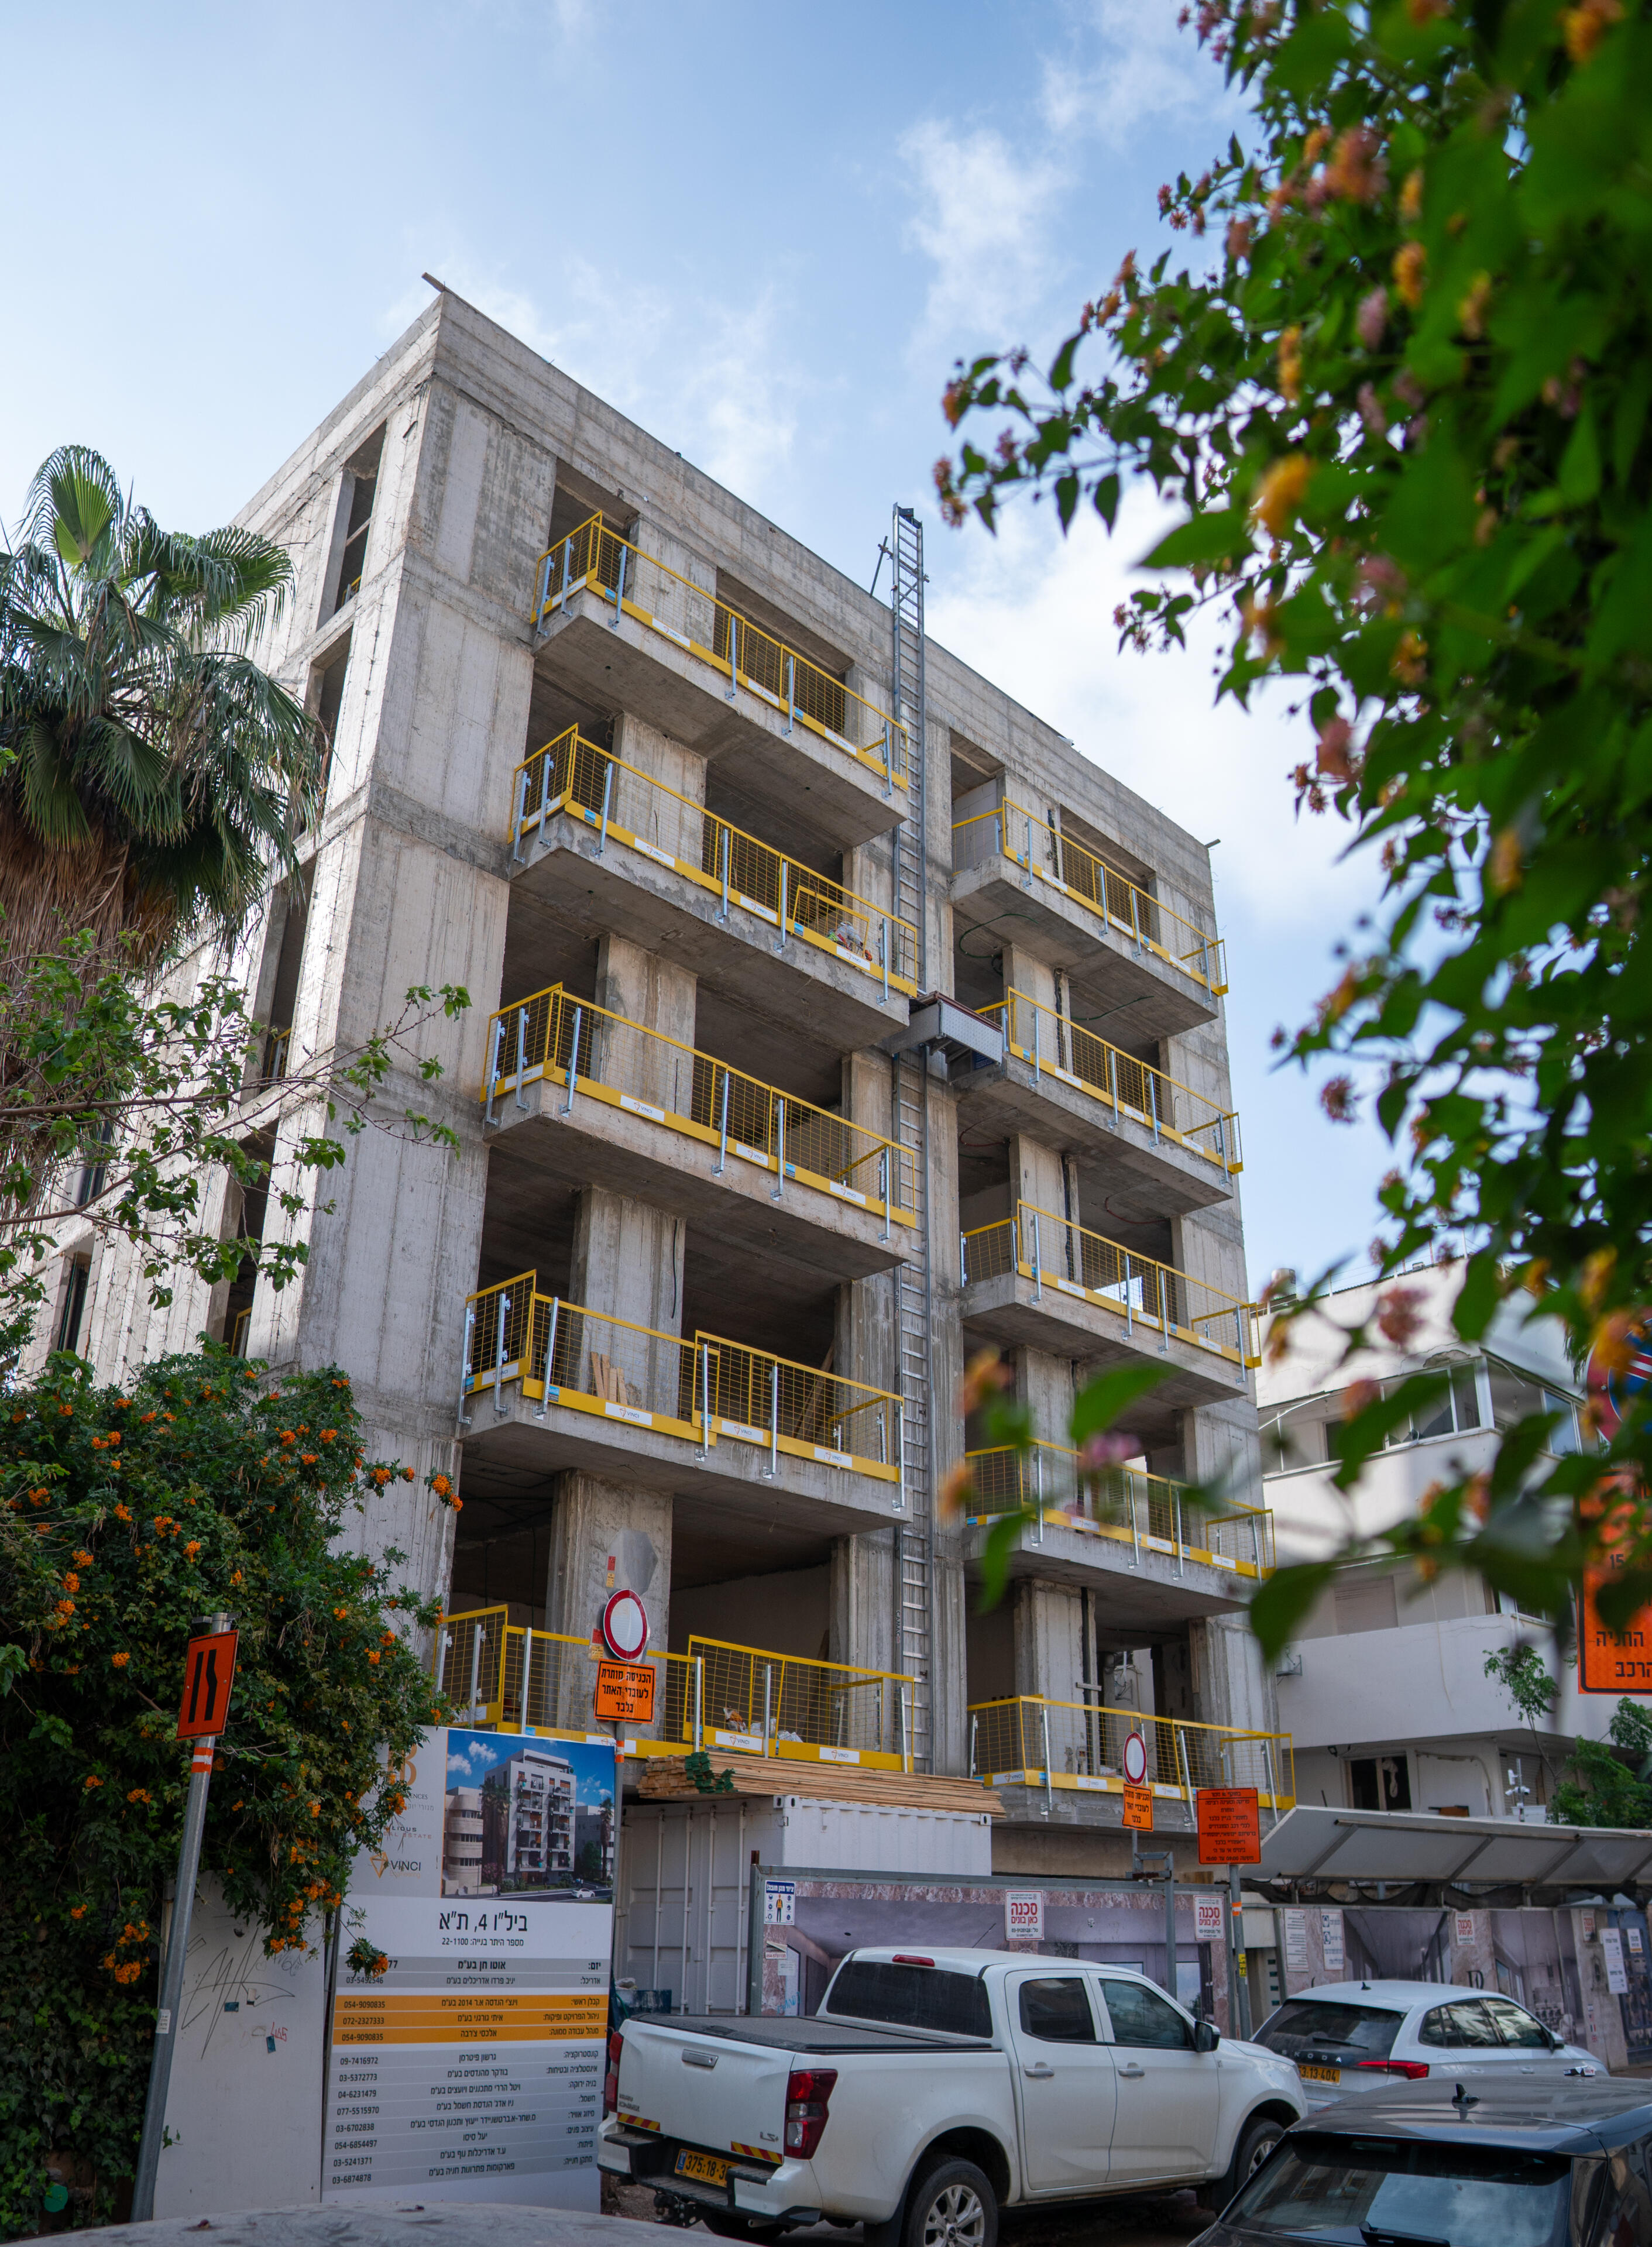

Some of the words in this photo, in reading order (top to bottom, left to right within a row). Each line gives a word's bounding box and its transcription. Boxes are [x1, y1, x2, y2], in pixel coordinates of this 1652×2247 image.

[602, 1668, 623, 1679] מותרת
[626, 1672, 651, 1684] הכניסה
[602, 1685, 621, 1695] האתר
[625, 1688, 648, 1699] לעובדי
[616, 1701, 633, 1713] בלבד
[1135, 1792, 1149, 1801] הכניסה
[391, 1860, 421, 1871] VINCI
[1011, 1903, 1038, 1915] סכנה
[1199, 1906, 1220, 1918] סכנה
[439, 1911, 468, 1930] ת"א
[474, 1914, 487, 1932] 4,
[494, 1910, 527, 1931] ביל"ו
[1028, 1916, 1038, 1926] כאן
[458, 1960, 476, 1969] בע"מ
[479, 1961, 487, 1971] חן
[490, 1961, 506, 1970] אוטו
[463, 1976, 489, 1984] אדריכלים
[588, 1997, 600, 2006] קבלן
[543, 2014, 562, 2022] ופיקוח:
[564, 2013, 585, 2022] הפרויקט
[479, 2028, 497, 2037] אלכסי
[459, 2054, 479, 2063] פיטרמן
[481, 2053, 496, 2062] גרשון
[564, 2050, 599, 2059] קונסטרוקציה:
[1282, 2050, 1342, 2063] SKODA
[340, 2057, 379, 2065] 09-7416972
[464, 2069, 489, 2077] מהנדסים
[570, 2064, 597, 2073] אינסטלציה
[339, 2074, 377, 2082] 03-5372773
[448, 2070, 462, 2078] בע"מ
[469, 2085, 493, 2093] מתכננים
[568, 2081, 584, 2089] ירוקה:
[338, 2090, 377, 2098] 04-6231479
[579, 2094, 596, 2102] חשמל:
[453, 2101, 471, 2109] חשמל
[337, 2107, 379, 2115] 077-5515970
[410, 2120, 426, 2128] בע"מ
[447, 2118, 463, 2128] ותכנון
[465, 2117, 479, 2126] ייעוץ
[336, 2124, 375, 2132] 03-6702838
[478, 2132, 487, 2141] יעל
[335, 2140, 377, 2150] 054-6854497
[458, 2150, 466, 2159] נוף
[468, 2148, 495, 2157] אדריכלות
[334, 2157, 372, 2167] 03-5241371
[579, 2156, 592, 2164] מתקן
[429, 2167, 444, 2176] בע"מ
[446, 2167, 459, 2175] חניה
[461, 2165, 485, 2174] פתרונות
[332, 2174, 371, 2184] 03-6874878
